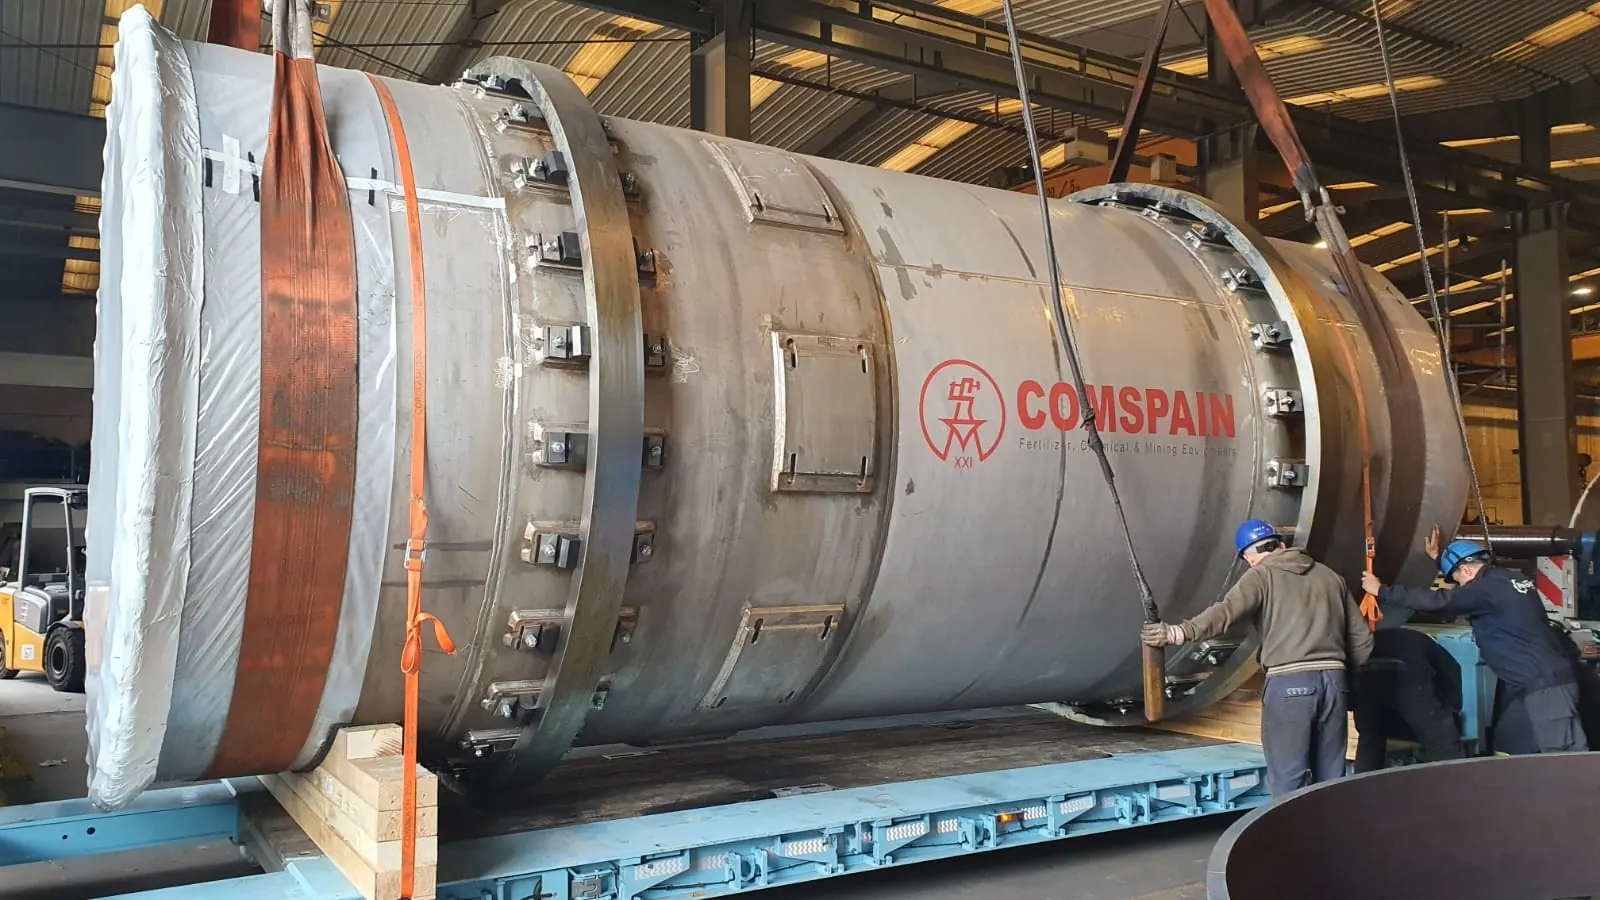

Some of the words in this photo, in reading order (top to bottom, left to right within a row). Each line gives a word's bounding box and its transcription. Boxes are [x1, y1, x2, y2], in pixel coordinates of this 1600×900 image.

[1017, 379, 1236, 438] COMSPAIN
[1019, 437, 1076, 453] Fertilizr,
[1145, 442, 1177, 457] Mining
[1182, 443, 1237, 457] Equipents
[954, 455, 973, 468] XXI
